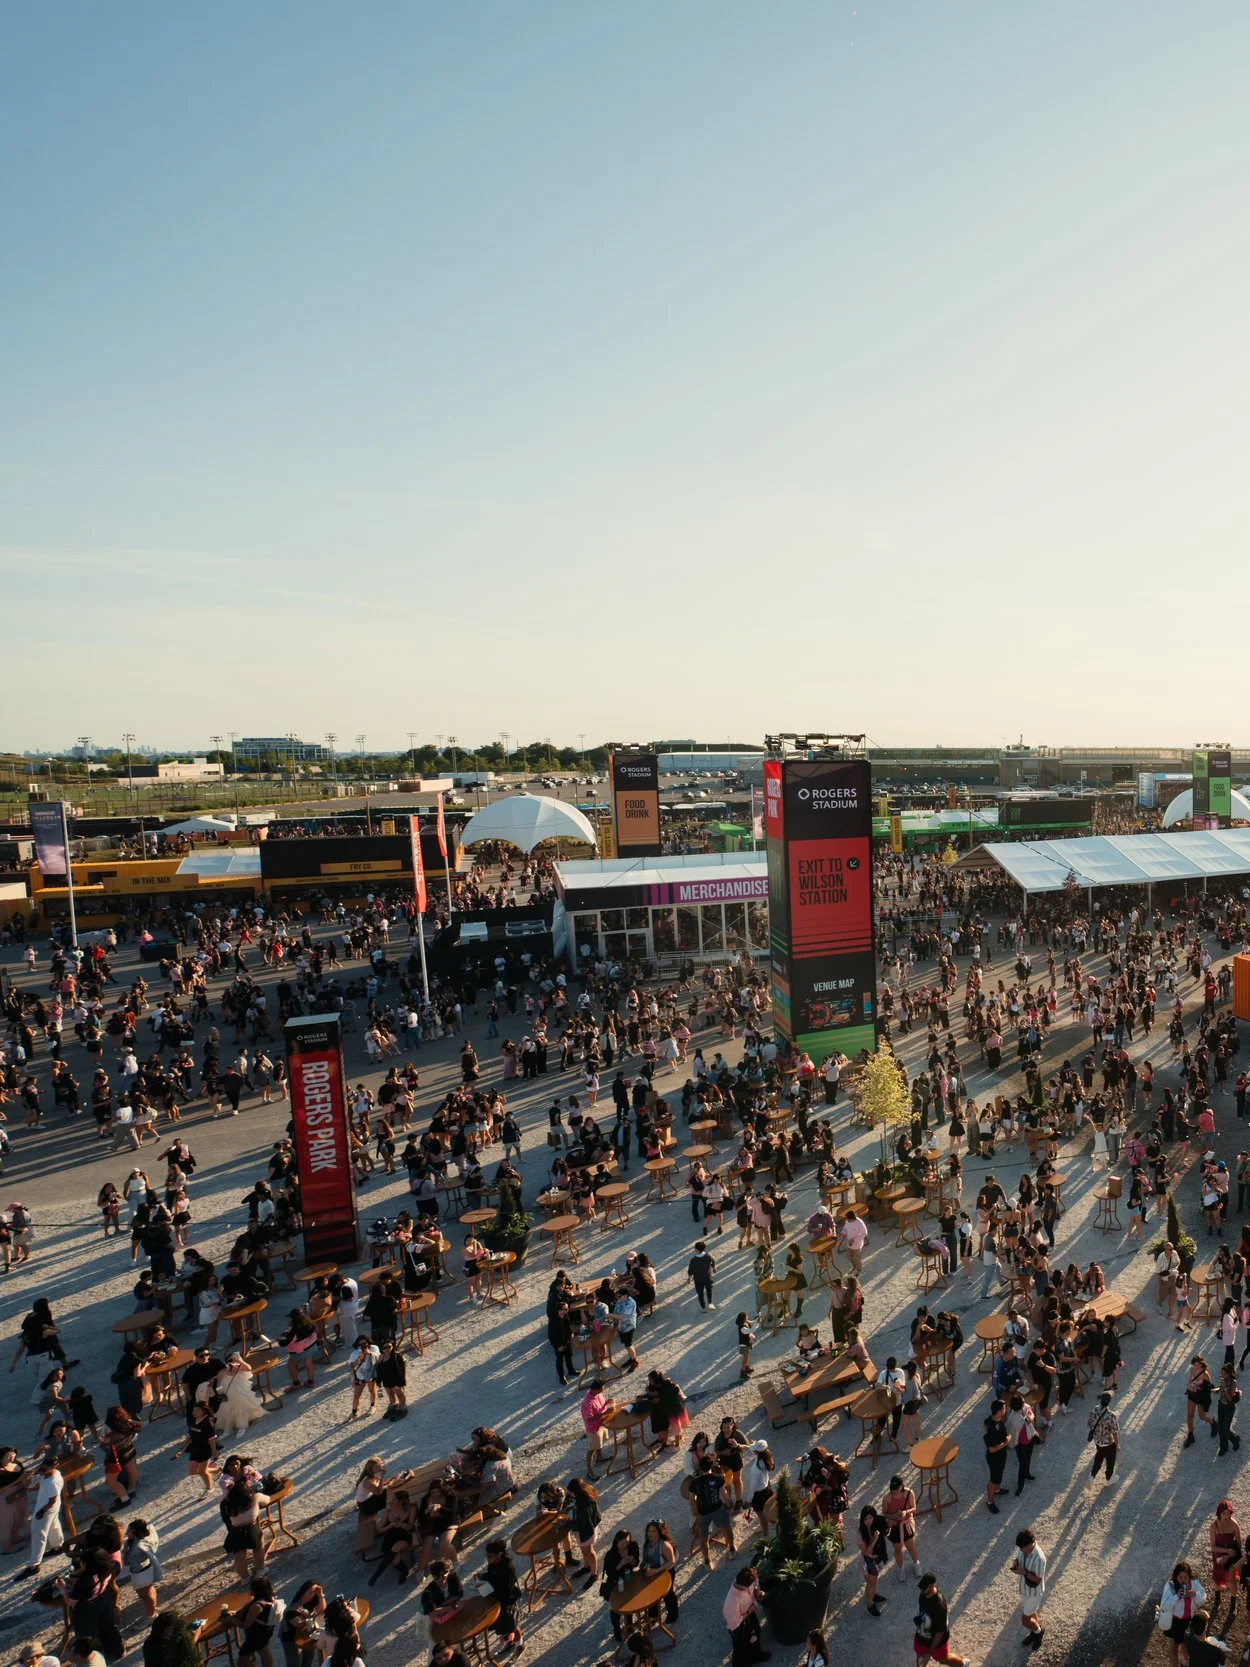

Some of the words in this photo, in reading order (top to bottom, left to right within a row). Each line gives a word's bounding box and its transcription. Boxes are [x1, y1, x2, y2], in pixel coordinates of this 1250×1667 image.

[812, 788, 857, 799] ROGERS
[1213, 783, 1225, 791] FOOD
[625, 799, 645, 809] FOOD
[812, 799, 858, 810] STADIUM
[625, 809, 649, 819] DRINK
[798, 858, 825, 875] EXIT
[828, 857, 842, 873] TO
[157, 876, 172, 884] MIX
[799, 873, 844, 890] WILSON
[680, 880, 768, 901] MERCHANDISE
[799, 889, 848, 906] STATION
[813, 980, 837, 992] VENUE
[838, 978, 855, 989] MAP
[302, 1061, 334, 1126] ROGERS
[308, 1127, 338, 1174] PARK
